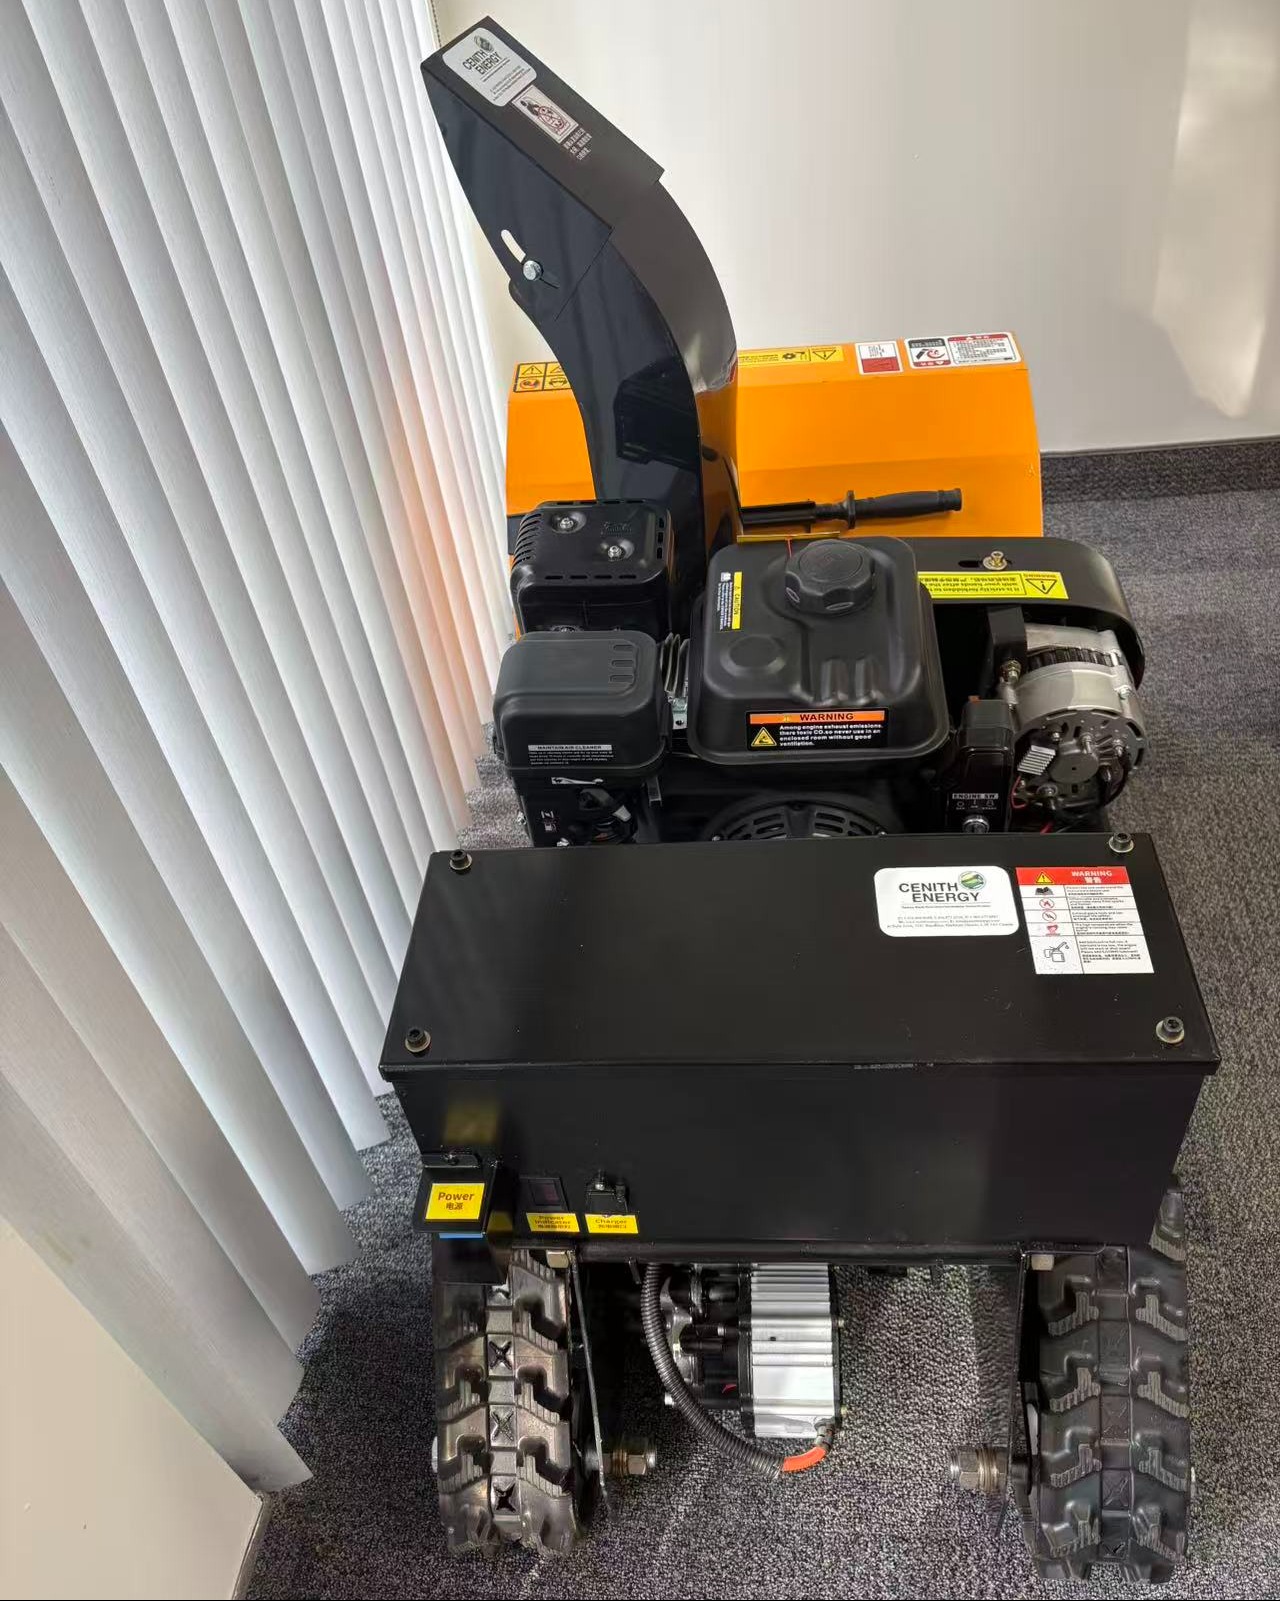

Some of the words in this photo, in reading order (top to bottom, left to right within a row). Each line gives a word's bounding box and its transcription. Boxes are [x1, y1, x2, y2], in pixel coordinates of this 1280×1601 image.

[462, 48, 488, 70] CENITH
[474, 51, 502, 75] ENERGY
[799, 712, 854, 721] WARNING
[898, 882, 959, 893] CENITH
[912, 892, 980, 903] ENERGY
[438, 1191, 475, 1201] Power
[446, 1202, 464, 1210] 电源
